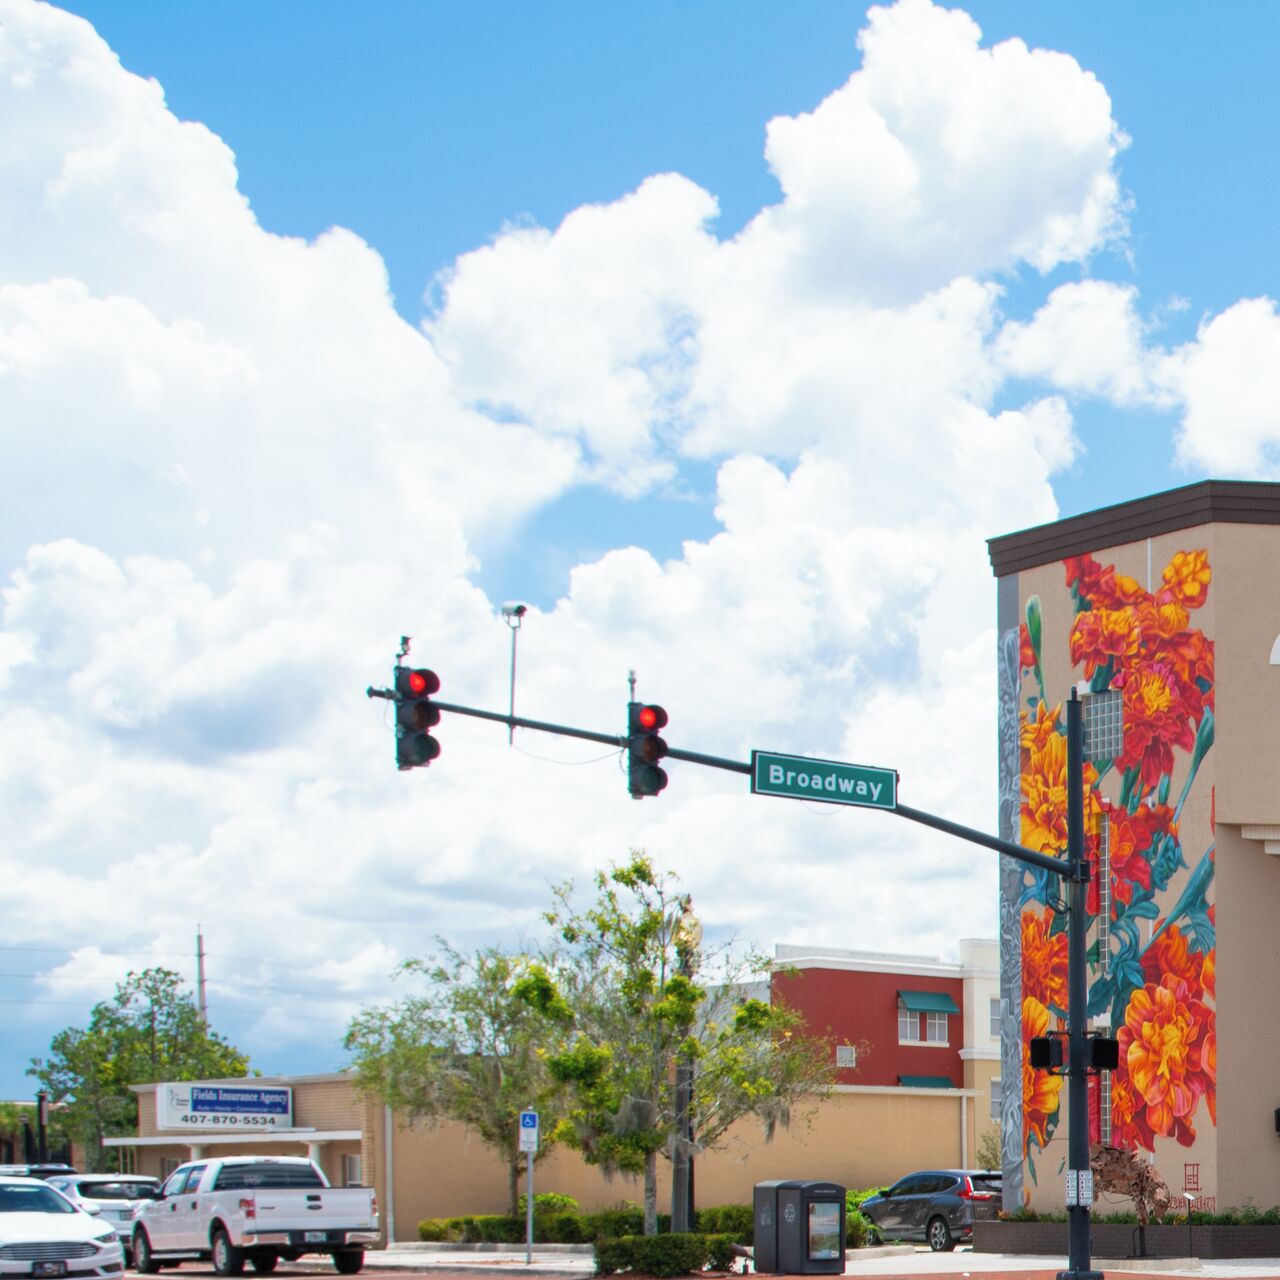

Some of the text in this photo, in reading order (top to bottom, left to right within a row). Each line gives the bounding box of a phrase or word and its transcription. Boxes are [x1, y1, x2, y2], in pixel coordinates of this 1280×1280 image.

[769, 764, 883, 801] Broadway
[193, 1088, 288, 1104] Fields Insurance Agency
[181, 1115, 276, 1125] 407-870-5534
